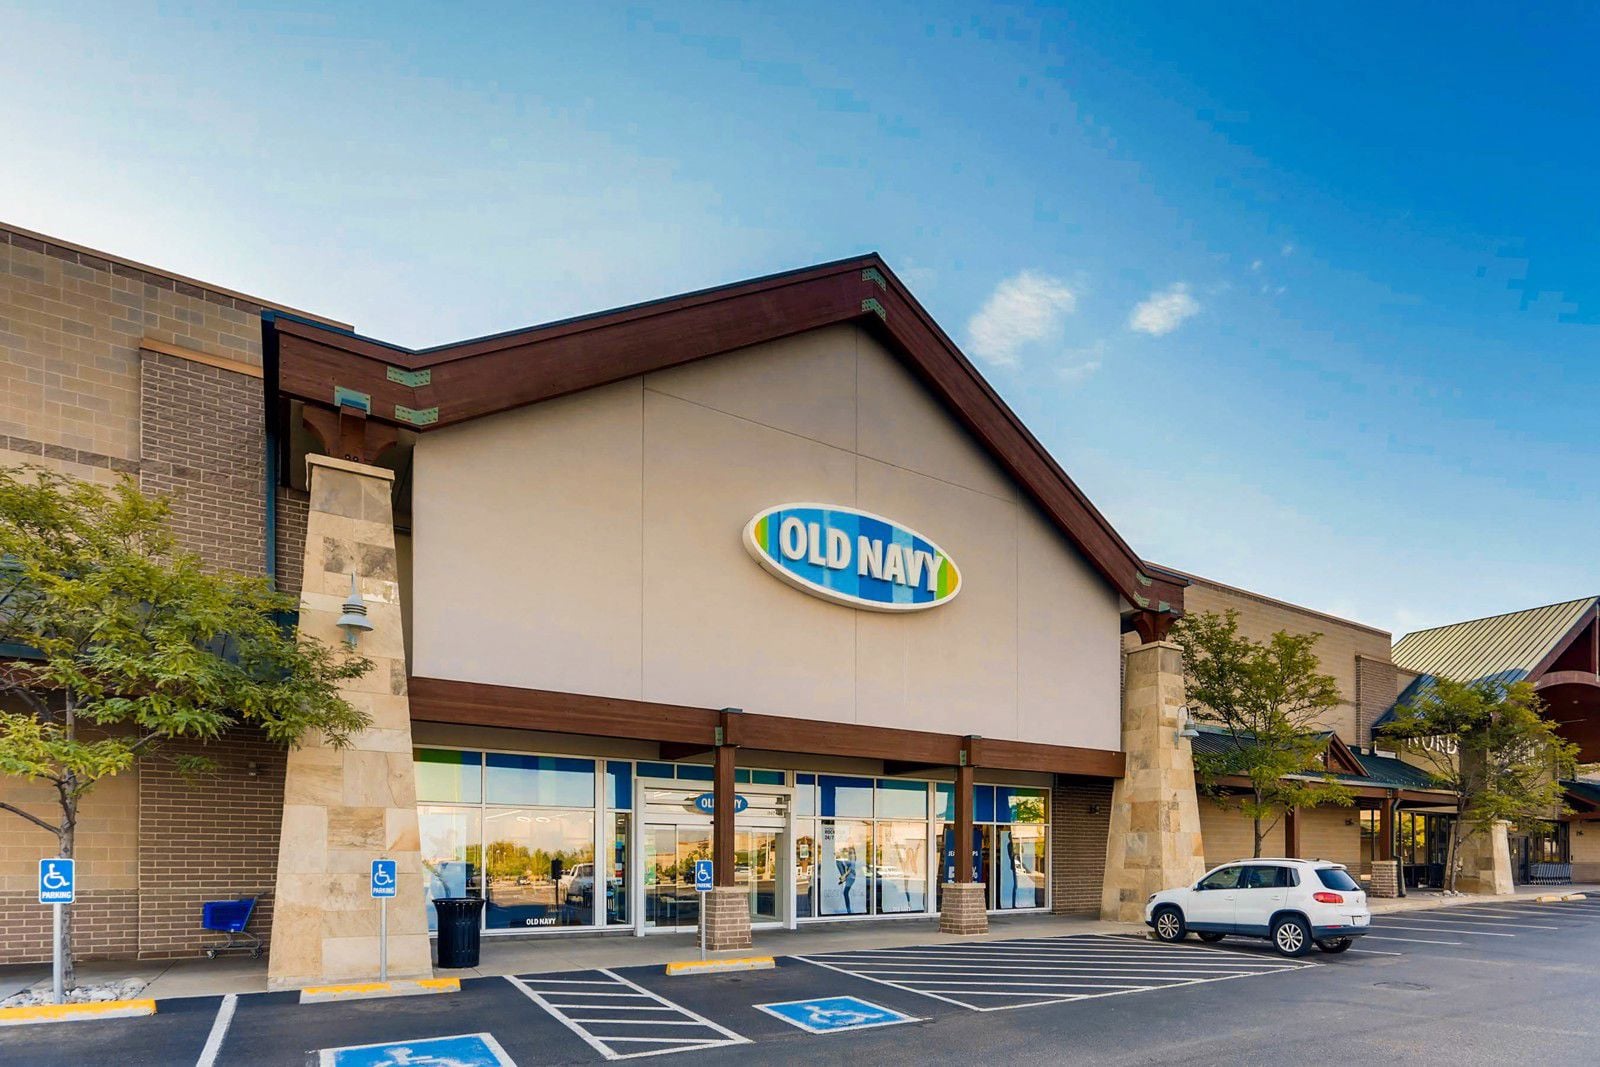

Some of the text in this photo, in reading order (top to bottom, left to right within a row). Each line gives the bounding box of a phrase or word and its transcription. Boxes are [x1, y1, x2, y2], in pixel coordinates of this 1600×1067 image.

[779, 516, 944, 592] OLD NAVY
[701, 797, 714, 808] OL
[41, 891, 72, 899] PARKING
[526, 917, 556, 926] OLD NAVY
